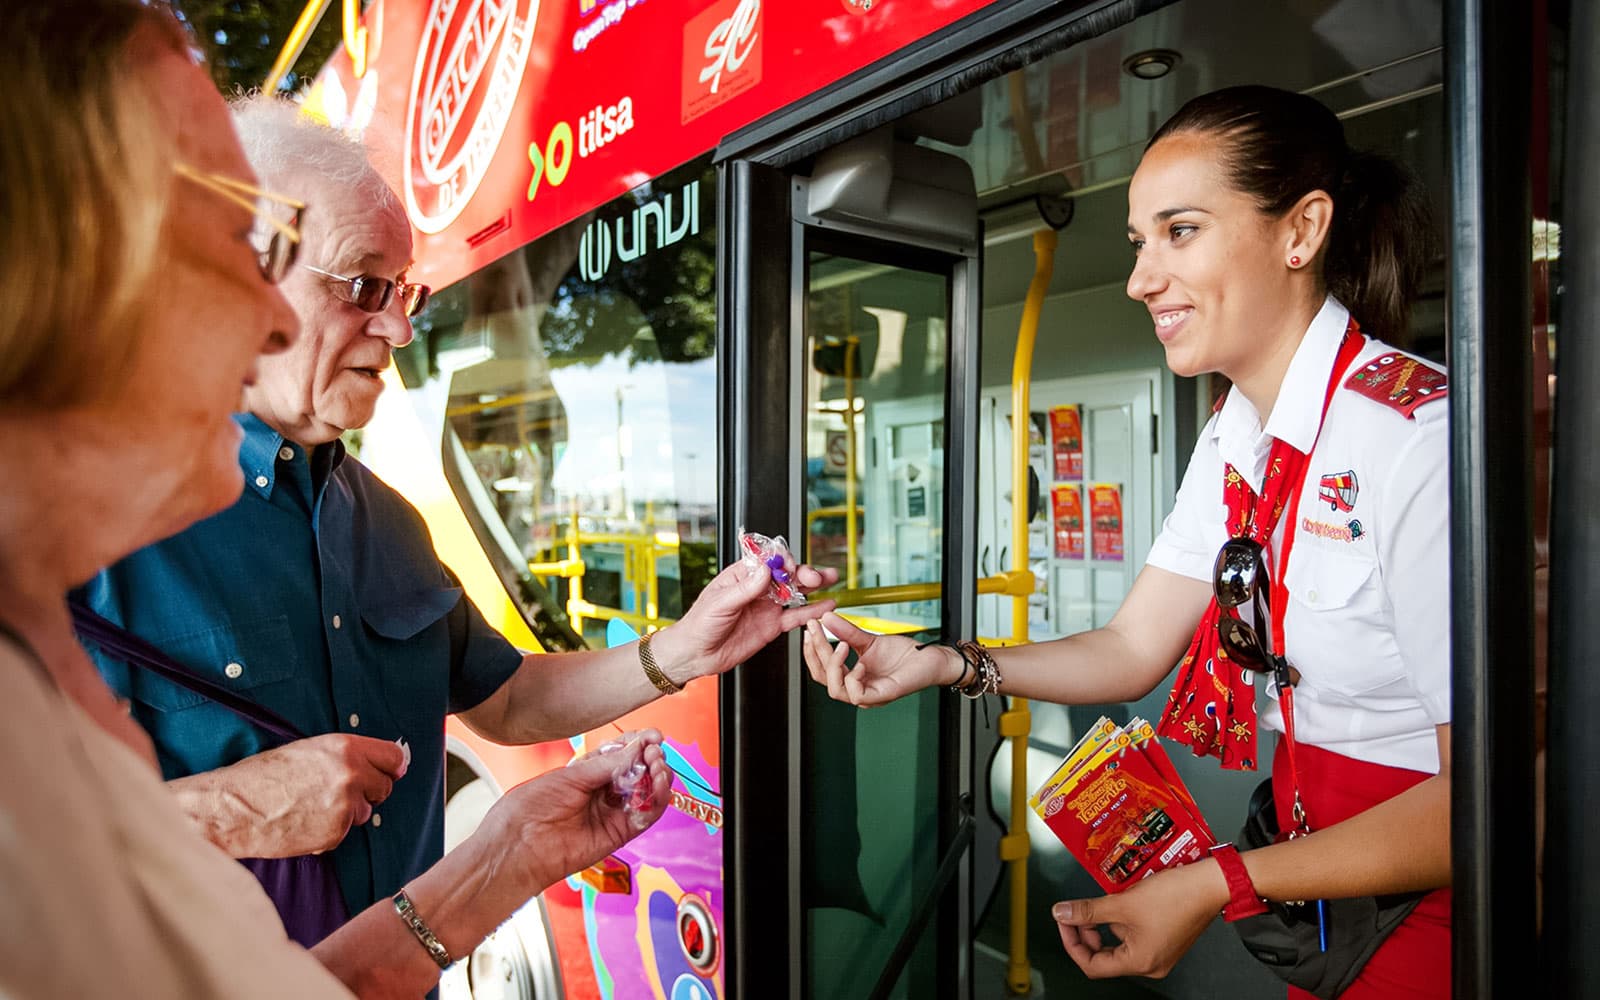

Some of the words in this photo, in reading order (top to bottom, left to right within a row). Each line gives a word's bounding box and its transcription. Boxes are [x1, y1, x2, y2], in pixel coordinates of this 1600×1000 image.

[578, 96, 634, 158] titsa
[671, 789, 723, 828] OLVO
[1076, 778, 1128, 824] Tenerife
